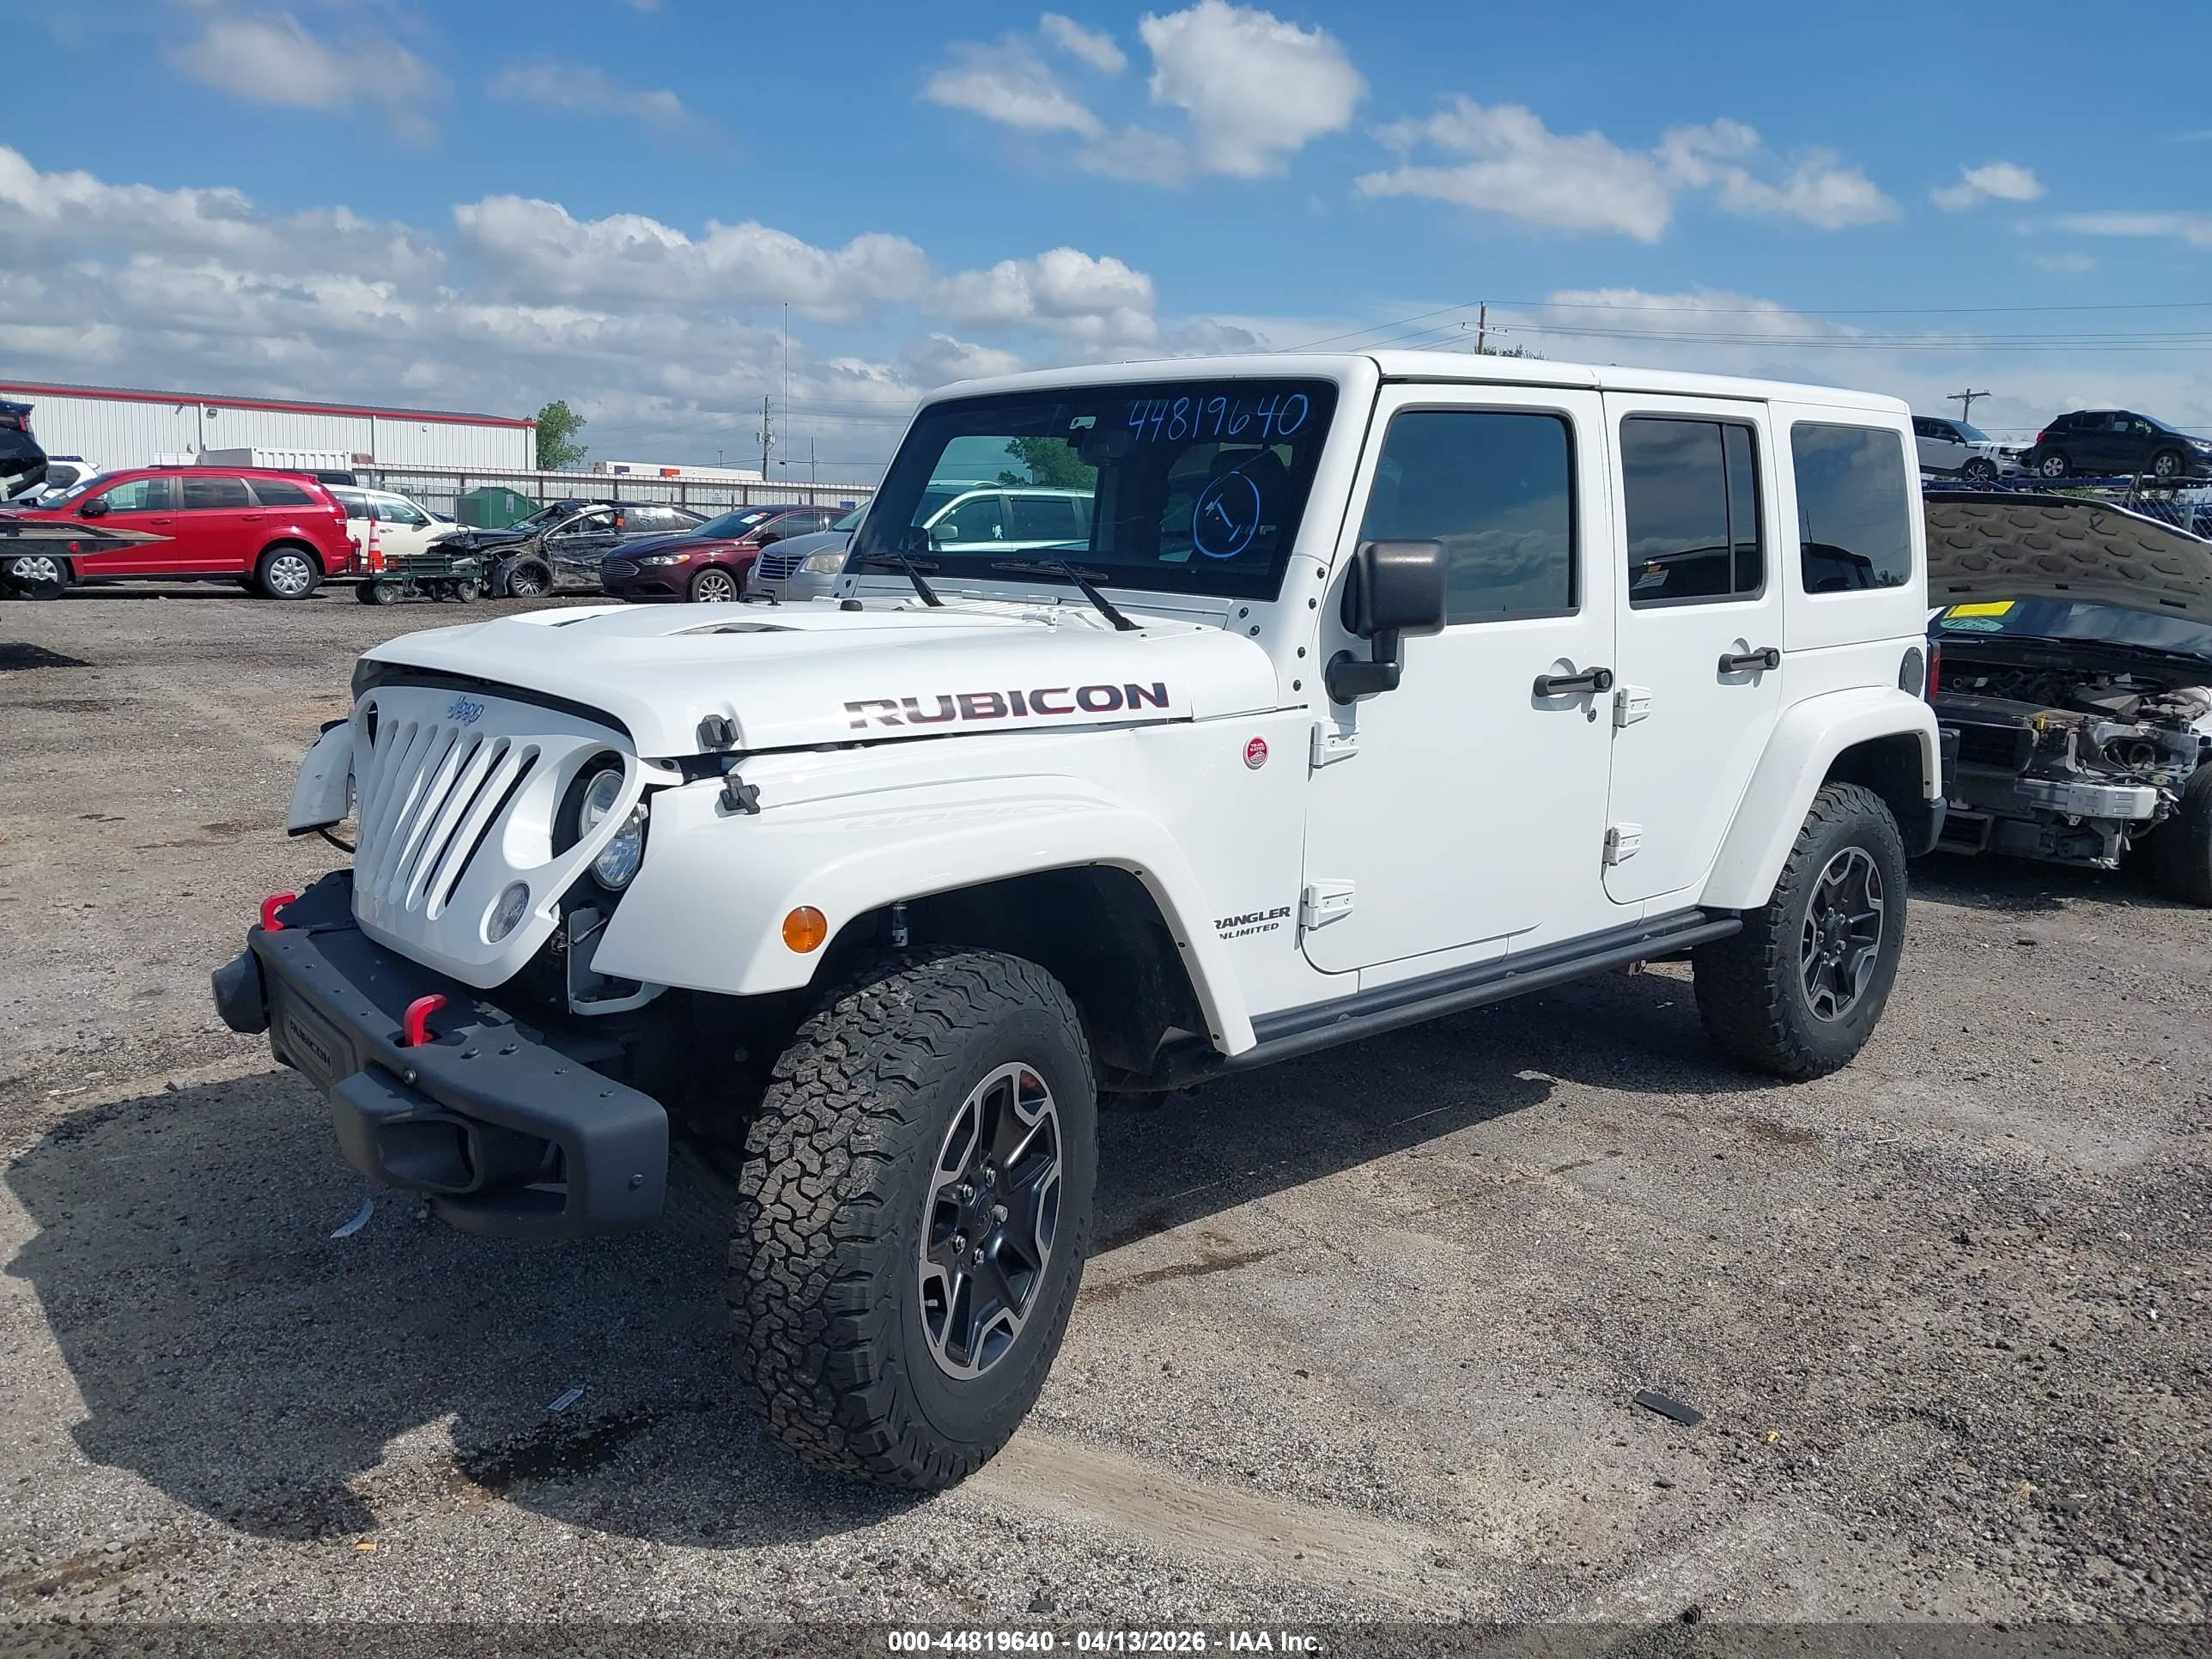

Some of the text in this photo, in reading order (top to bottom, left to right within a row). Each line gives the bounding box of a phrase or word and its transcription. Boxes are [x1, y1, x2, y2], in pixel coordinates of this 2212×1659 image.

[1128, 394, 1308, 442] 44819640
[447, 695, 484, 726] Jeep
[843, 682, 1170, 729] RUBICON
[1213, 906, 1291, 929] RANGLER
[1218, 922, 1279, 939] NLIMITED
